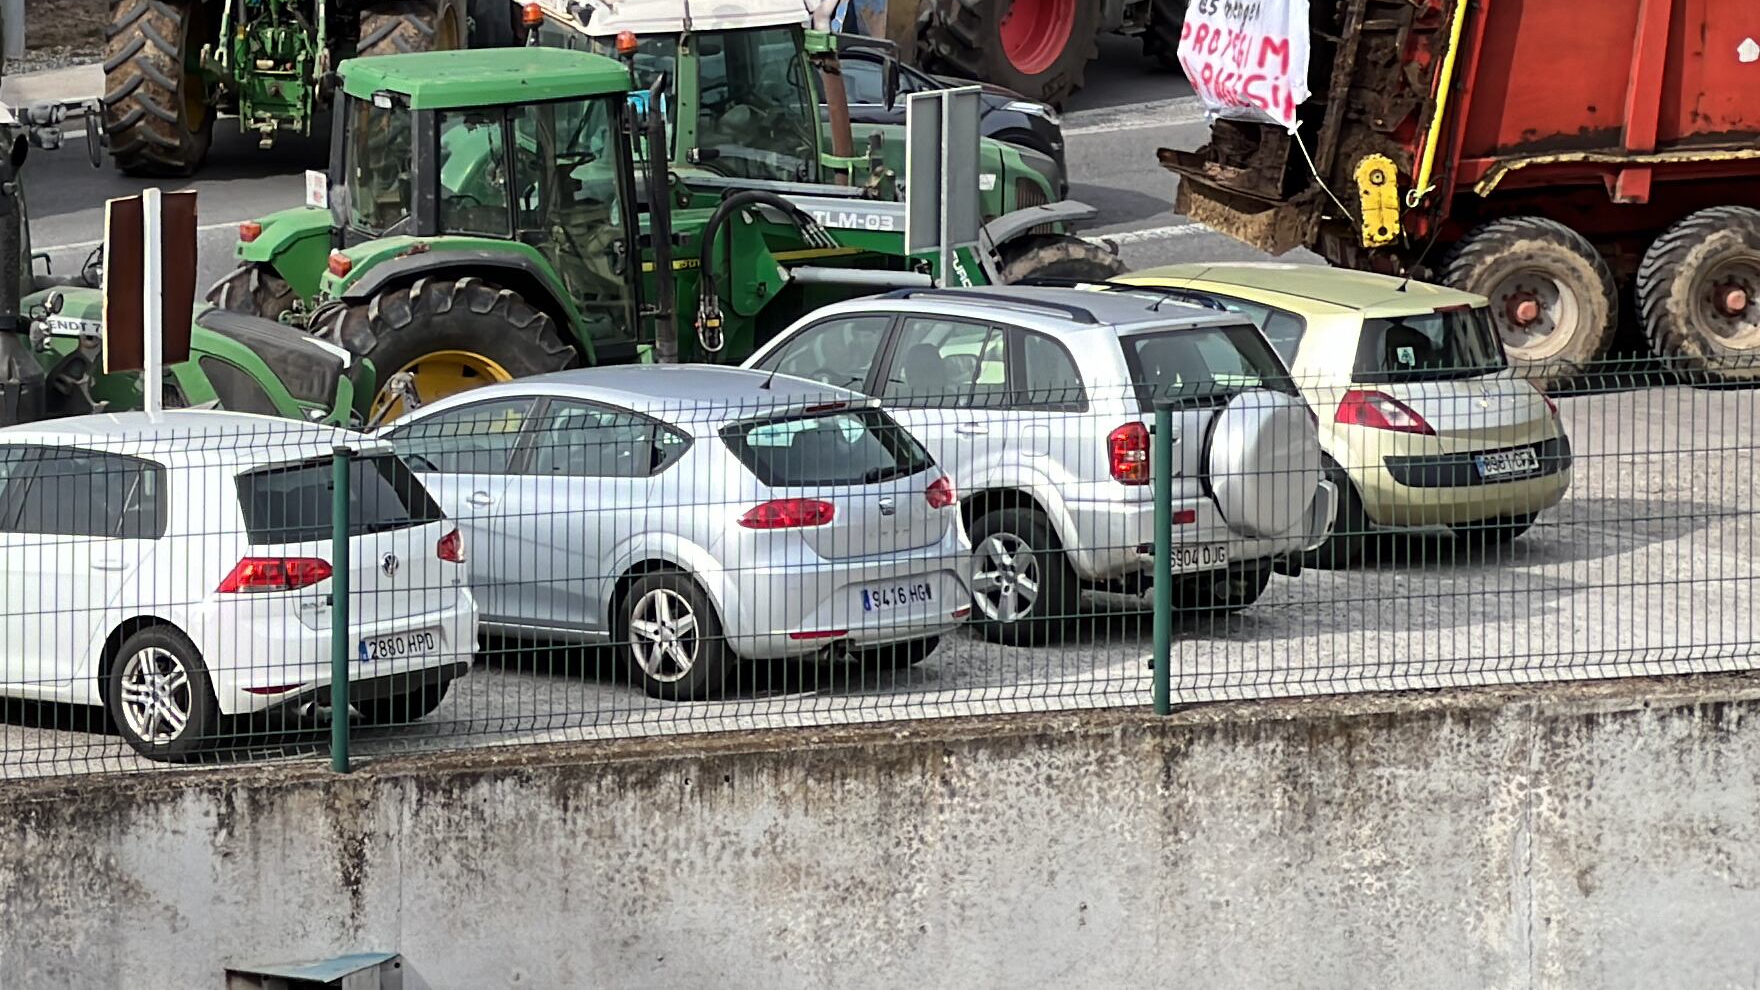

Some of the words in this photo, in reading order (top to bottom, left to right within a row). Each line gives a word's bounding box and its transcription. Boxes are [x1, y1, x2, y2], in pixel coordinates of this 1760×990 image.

[813, 210, 894, 231] TLM-03
[48, 319, 87, 332] ENDT
[1203, 546, 1225, 564] DJG
[369, 637, 405, 659] 2880
[408, 632, 434, 652] HPD
